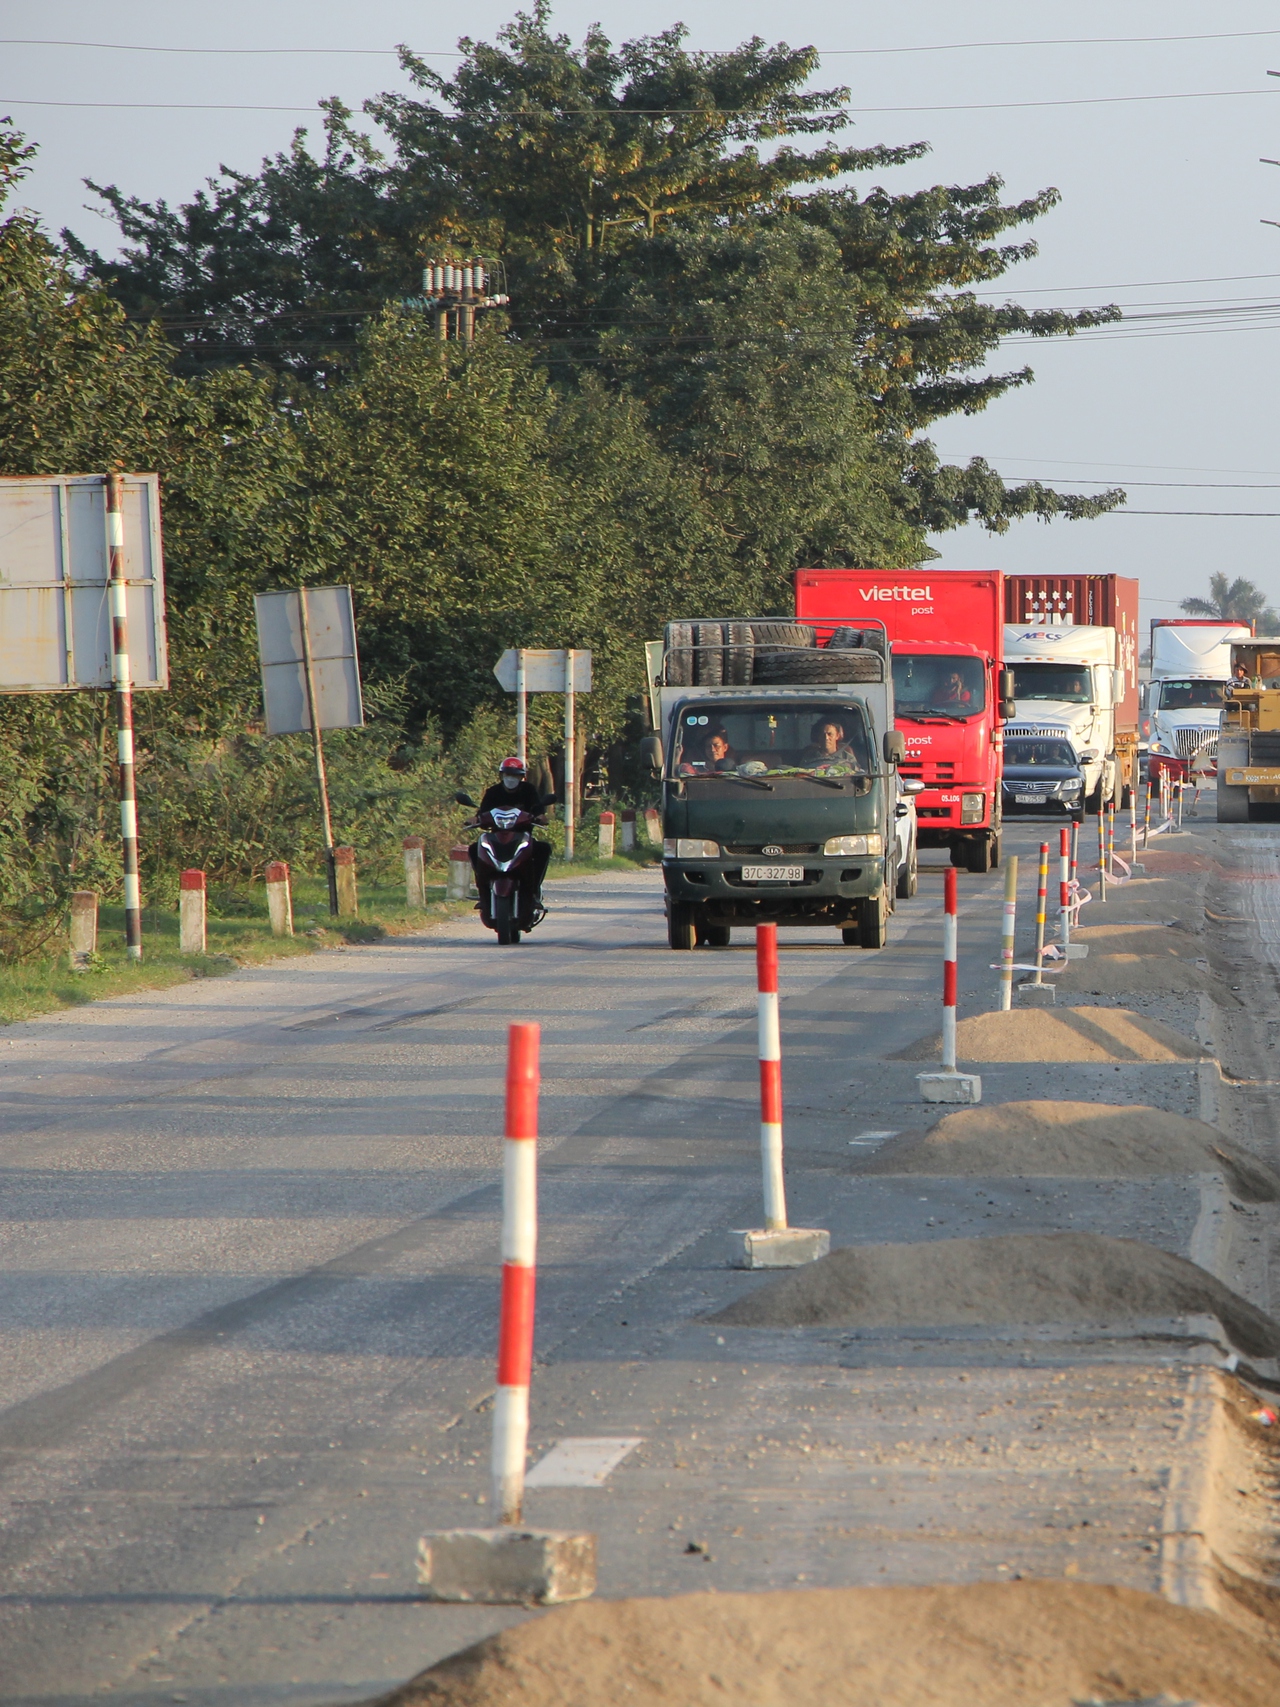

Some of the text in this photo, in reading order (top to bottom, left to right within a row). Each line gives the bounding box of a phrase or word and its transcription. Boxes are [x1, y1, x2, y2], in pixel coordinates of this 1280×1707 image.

[858, 585, 934, 601] viettel
[911, 606, 934, 616] post
[743, 867, 801, 879] 37C-327.98
